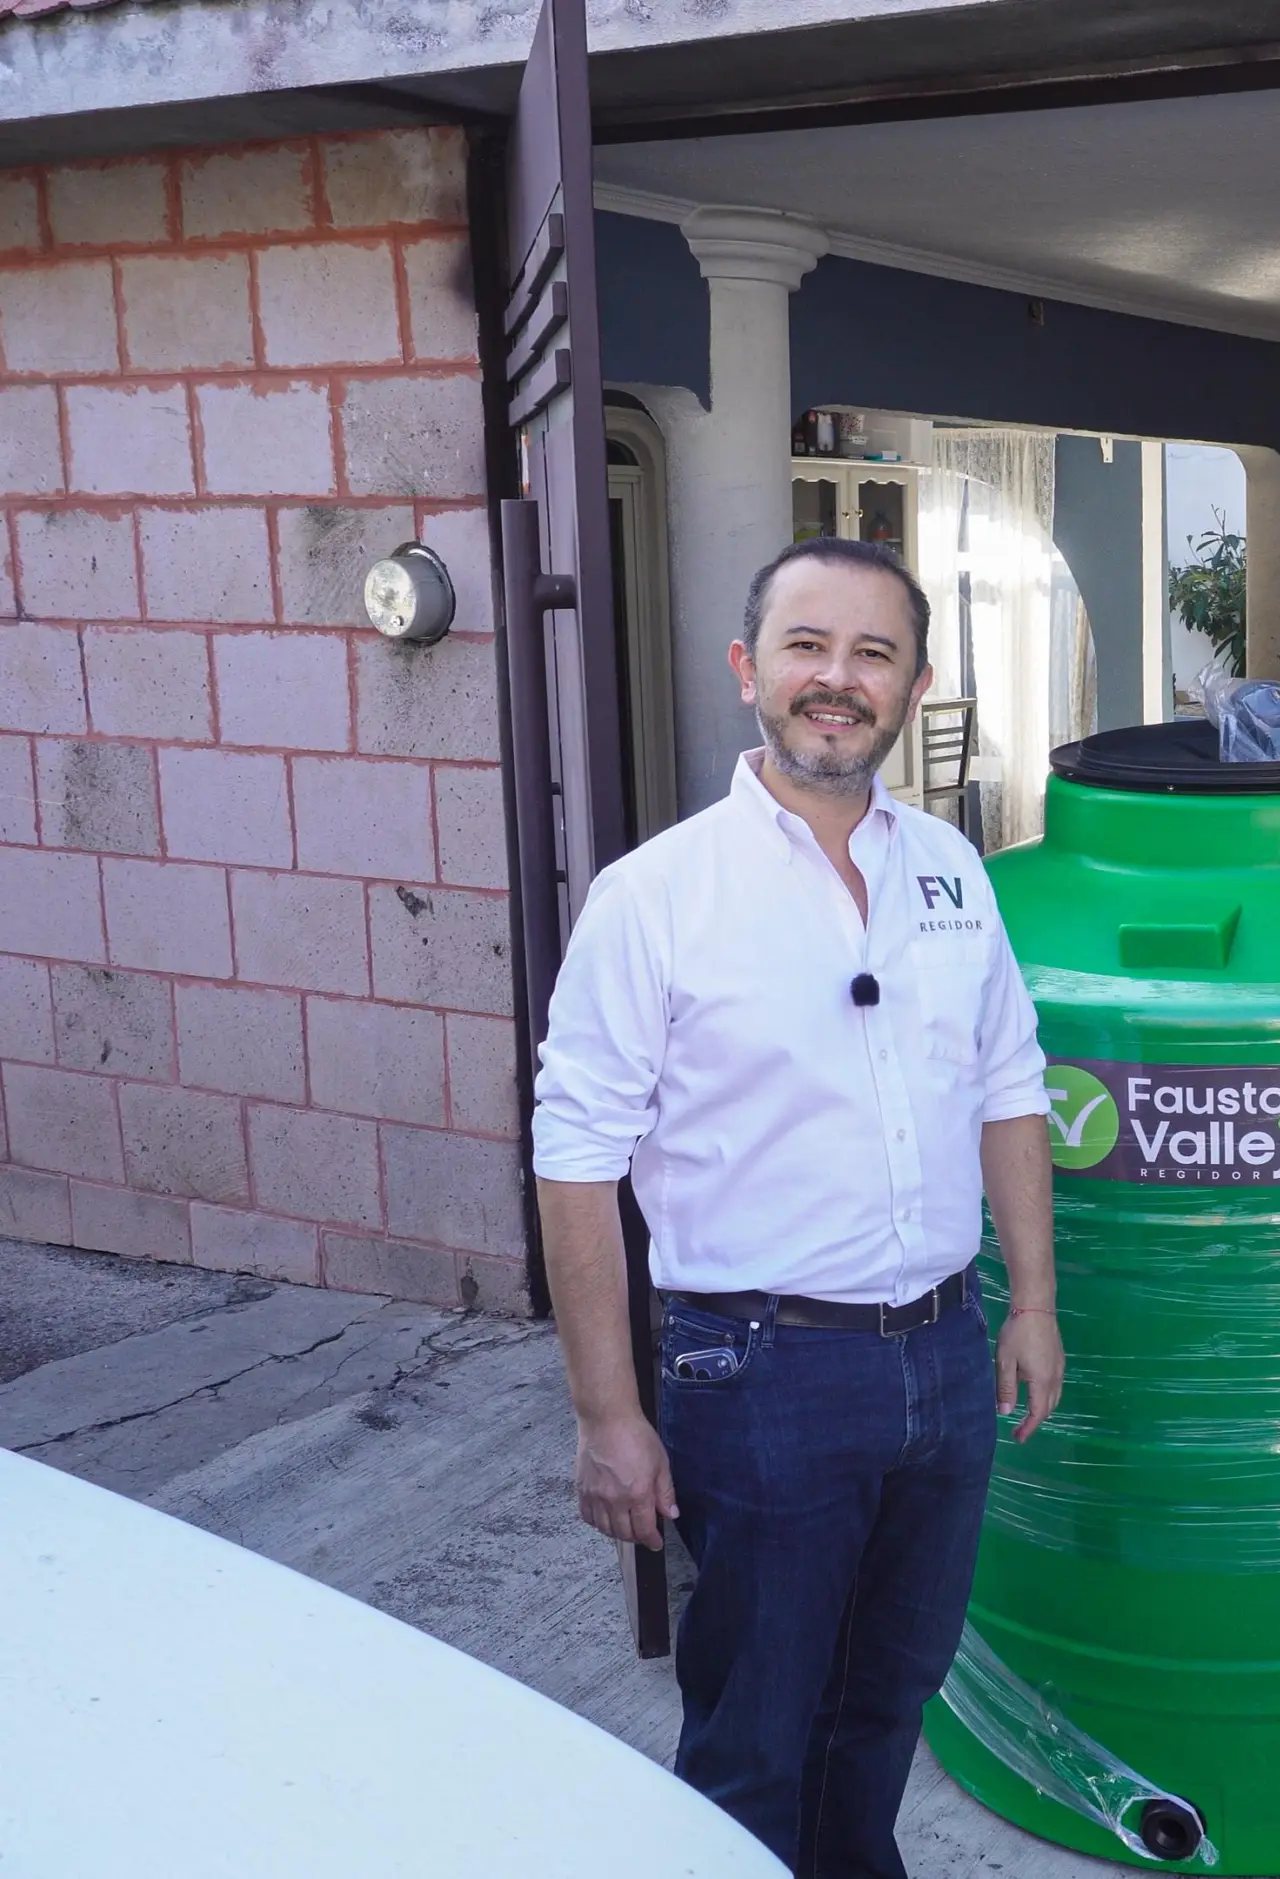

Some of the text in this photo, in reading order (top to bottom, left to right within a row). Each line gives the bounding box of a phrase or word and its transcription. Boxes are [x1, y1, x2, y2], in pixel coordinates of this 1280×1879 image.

[916, 875, 963, 910] FV
[919, 919, 983, 933] REGIDOR
[1140, 1168, 1261, 1180] REGIDOR
